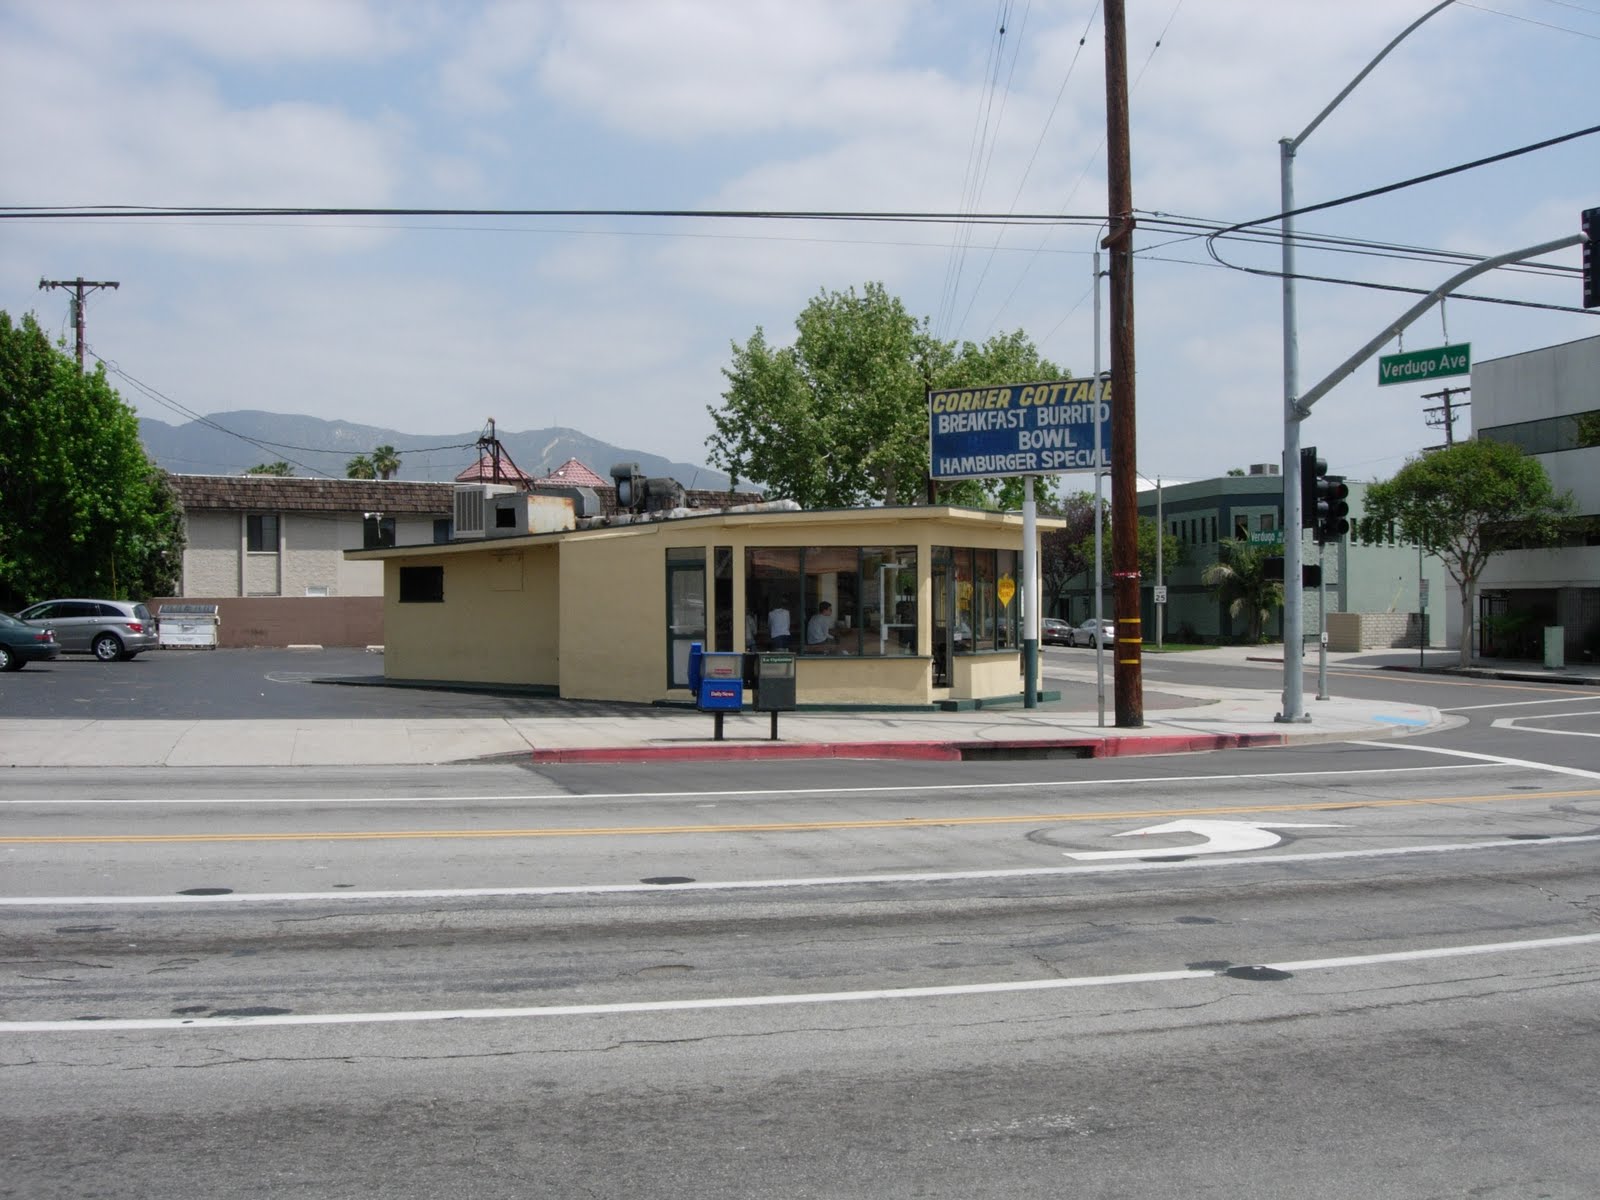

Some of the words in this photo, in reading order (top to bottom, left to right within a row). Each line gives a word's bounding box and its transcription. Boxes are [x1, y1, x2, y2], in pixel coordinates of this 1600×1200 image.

[1382, 360, 1436, 378] Verdugo
[1439, 354, 1466, 370] Ave
[932, 388, 1012, 414] CORNER
[938, 409, 1027, 434] BREAKFAST
[1037, 403, 1111, 427] BURRITO
[1019, 428, 1078, 451] BOWL
[940, 453, 1037, 475] HAMBURGER
[1155, 594, 1166, 602] 25
